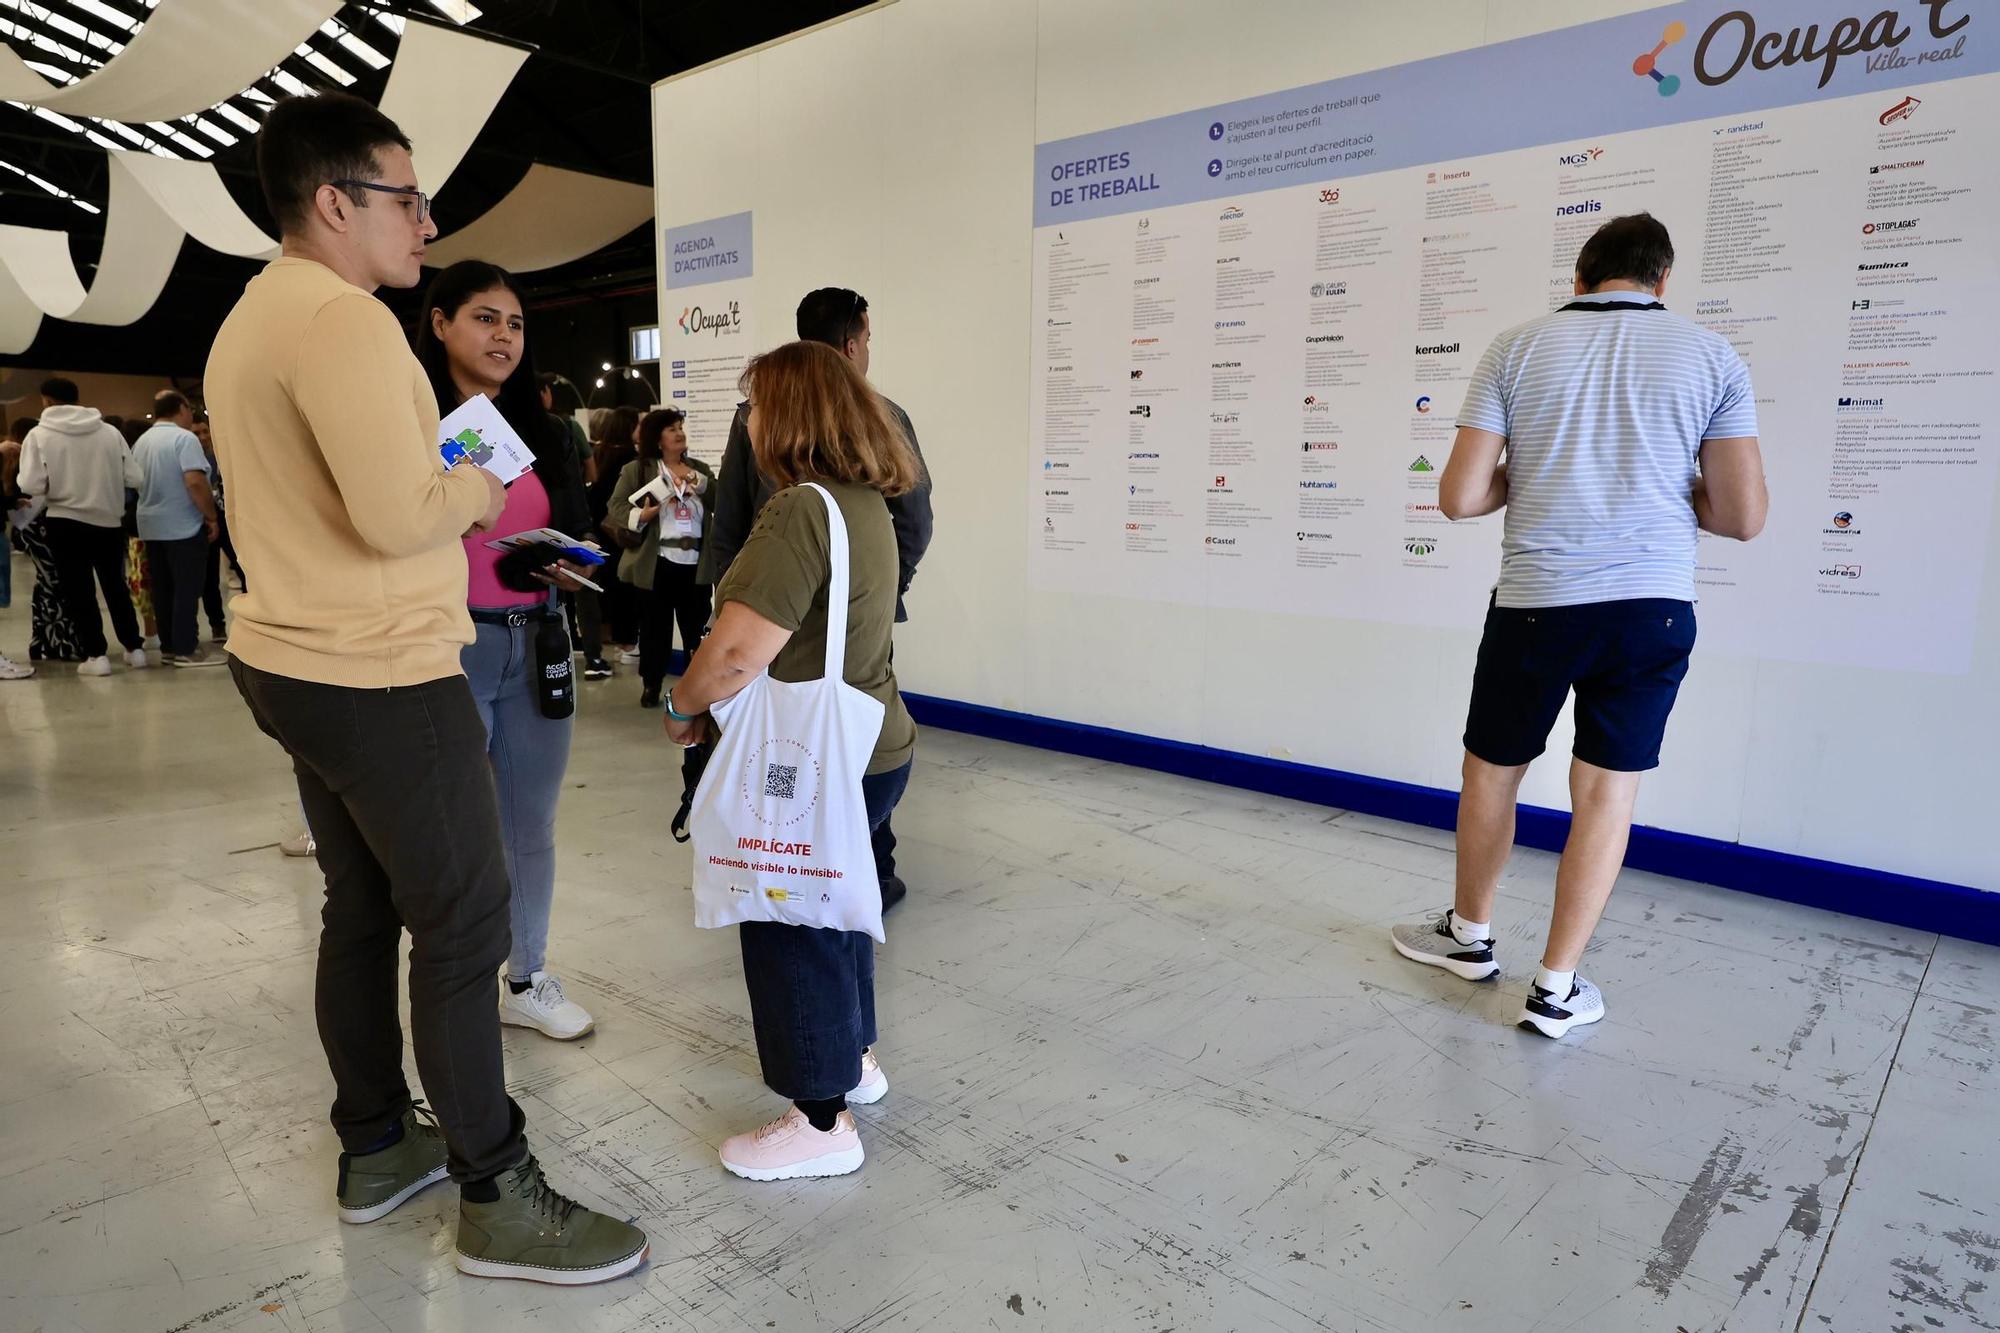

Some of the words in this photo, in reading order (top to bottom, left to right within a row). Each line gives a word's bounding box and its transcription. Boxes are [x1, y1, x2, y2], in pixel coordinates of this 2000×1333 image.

[1693, 0, 1970, 89] Ocupat
[1865, 35, 1967, 74] Vila-real
[1227, 117, 1260, 132] Elegeix
[1262, 114, 1275, 124] les
[1276, 108, 1310, 121] ofertes
[1311, 104, 1325, 115] de
[1326, 97, 1358, 112] treball
[1361, 92, 1381, 105] que
[1227, 129, 1266, 144] s'ajusten
[1268, 124, 1276, 135] al
[1278, 124, 1294, 134] teu
[1727, 121, 1764, 134] randstad
[1226, 151, 1273, 169] Dirigeix-te
[1274, 148, 1283, 160] al
[1284, 145, 1307, 161] punt
[1309, 134, 1374, 153] d'acreditació
[1560, 153, 1588, 166] MGS
[1051, 152, 1131, 182] OFERTES
[1225, 170, 1246, 181] amb
[1247, 167, 1256, 177] el
[1258, 165, 1273, 176] teu
[1275, 155, 1327, 173] curriculum
[1329, 154, 1343, 164] en
[1344, 147, 1377, 165] paper.
[1880, 160, 1925, 171] SMALTICERAM
[1443, 170, 1471, 181] Inserta
[1050, 189, 1074, 207] DE
[1078, 173, 1160, 203] TREBALL
[1220, 212, 1244, 222] elecnor
[1557, 200, 1602, 217] nealis
[1876, 220, 1917, 231] STOPLAGAS
[674, 236, 715, 255] AGENDA
[674, 250, 739, 273] D'ACTIVITATS
[1857, 261, 1909, 272] Suminca
[1697, 298, 1729, 308] randstad
[690, 300, 741, 338] Ocupa't
[1415, 343, 1460, 356] kerakoll
[1300, 481, 1337, 489] Huhtamaki
[1415, 504, 1442, 512] MAPF
[1212, 537, 1236, 545] Castel
[1819, 564, 1856, 577] vidres
[737, 837, 812, 856] IMPLÍCATE
[709, 856, 749, 870] Haciendo
[751, 861, 785, 874] visible
[788, 865, 798, 875] lo
[800, 866, 844, 879] invisible
